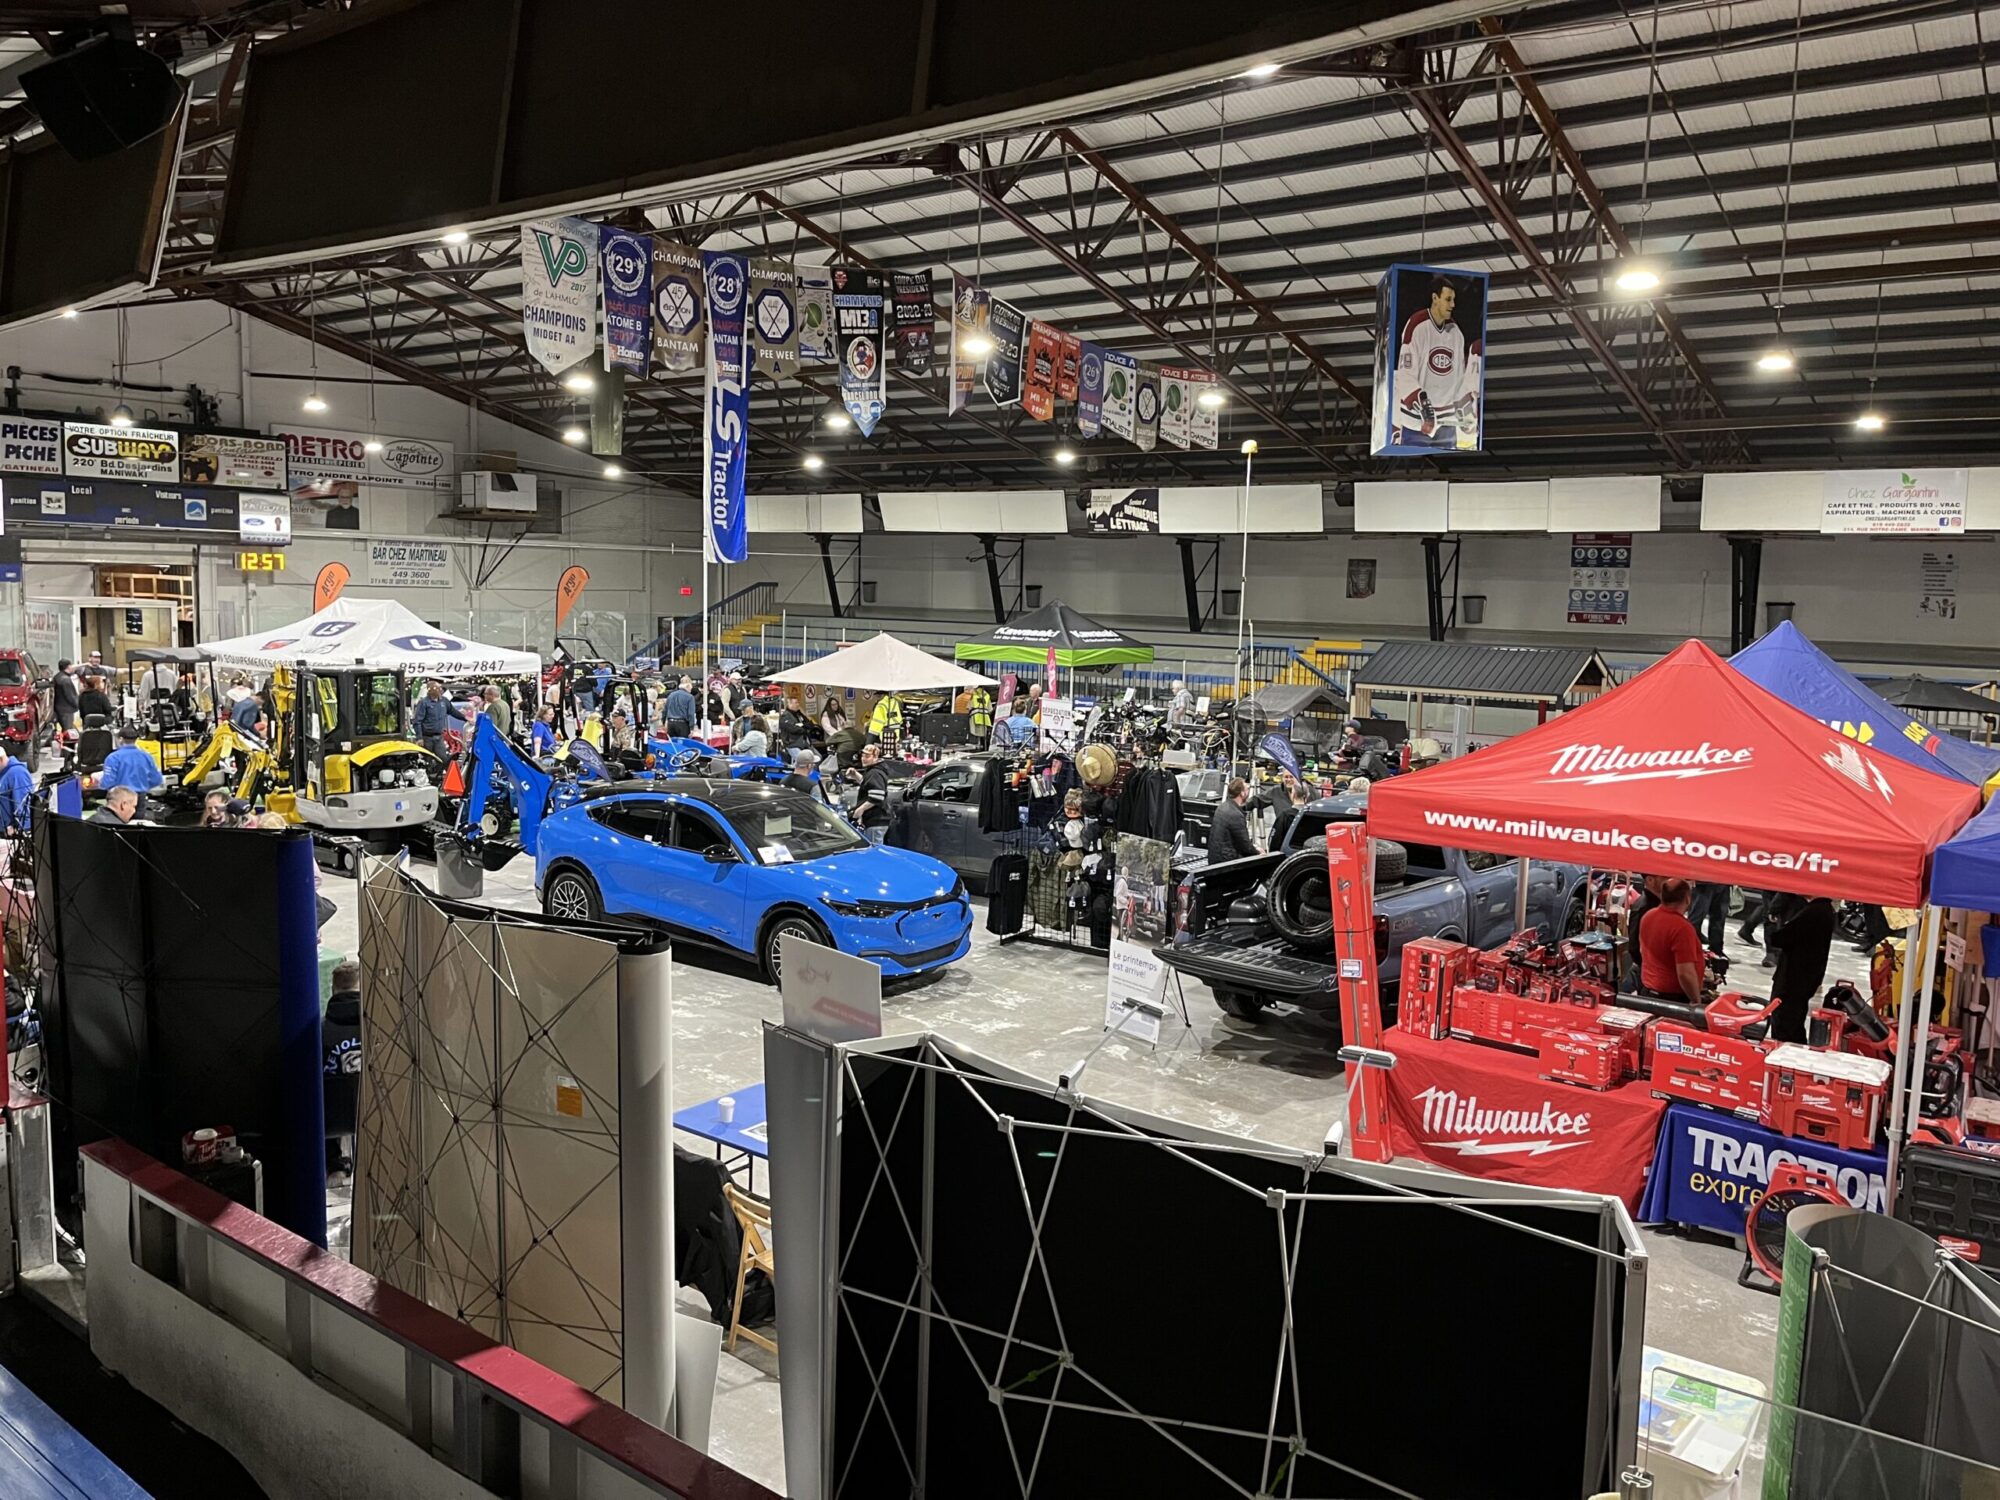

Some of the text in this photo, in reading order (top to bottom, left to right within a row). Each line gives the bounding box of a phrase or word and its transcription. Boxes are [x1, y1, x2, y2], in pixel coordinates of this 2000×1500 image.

[654, 250, 701, 269] CHAMPION
[752, 269, 793, 281] CHAMPION
[570, 282, 587, 294] 2017
[833, 294, 883, 308] CHAMPIONS
[524, 304, 586, 332] CHAMPIONS
[840, 309, 878, 328] M13A
[897, 304, 932, 318] 2022-23
[533, 327, 576, 345] MIDGET AA
[713, 334, 739, 345] ANTAM
[657, 337, 699, 353] BANTAM
[760, 349, 794, 360] PEE WEE
[1105, 352, 1136, 367] NOVICE A
[773, 361, 781, 373] A
[1161, 368, 1189, 379] NOVICE B
[2, 422, 58, 442] PIÈCES
[69, 425, 174, 441] VOTRE OPTION FRAÎCHEUR
[1102, 415, 1132, 438] FINALISTE
[72, 437, 173, 460] SUBWAY
[194, 435, 285, 451] HORS-BORD
[278, 433, 365, 461] METRO
[5, 444, 57, 461] PICHÉ
[386, 450, 439, 469] Lapointe
[714, 379, 741, 530] LS Tractor
[100, 469, 149, 478] MANIWAKI
[356, 475, 404, 484] LAPOINTE
[71, 485, 92, 495] Local
[1848, 486, 1940, 501] Chez Gargantini
[10, 497, 37, 505] punition
[1110, 517, 1149, 532] LETTRAGE
[241, 553, 285, 570] 12:57
[373, 547, 447, 561] BAR CHEZ MARTINEAU
[322, 570, 335, 597] Argo
[563, 573, 576, 597] Argo
[317, 624, 342, 635] LS
[995, 626, 1060, 638] Kawasaki
[409, 638, 448, 650] LS
[1548, 740, 1753, 776] Milwaukee
[1424, 808, 1840, 874] www.milwaukeetool.ca/fr
[1112, 962, 1124, 972] est
[1113, 951, 1158, 972] Le printemps
[1694, 1047, 1742, 1066] FUEL
[1411, 1085, 1591, 1135] Milwaukee
